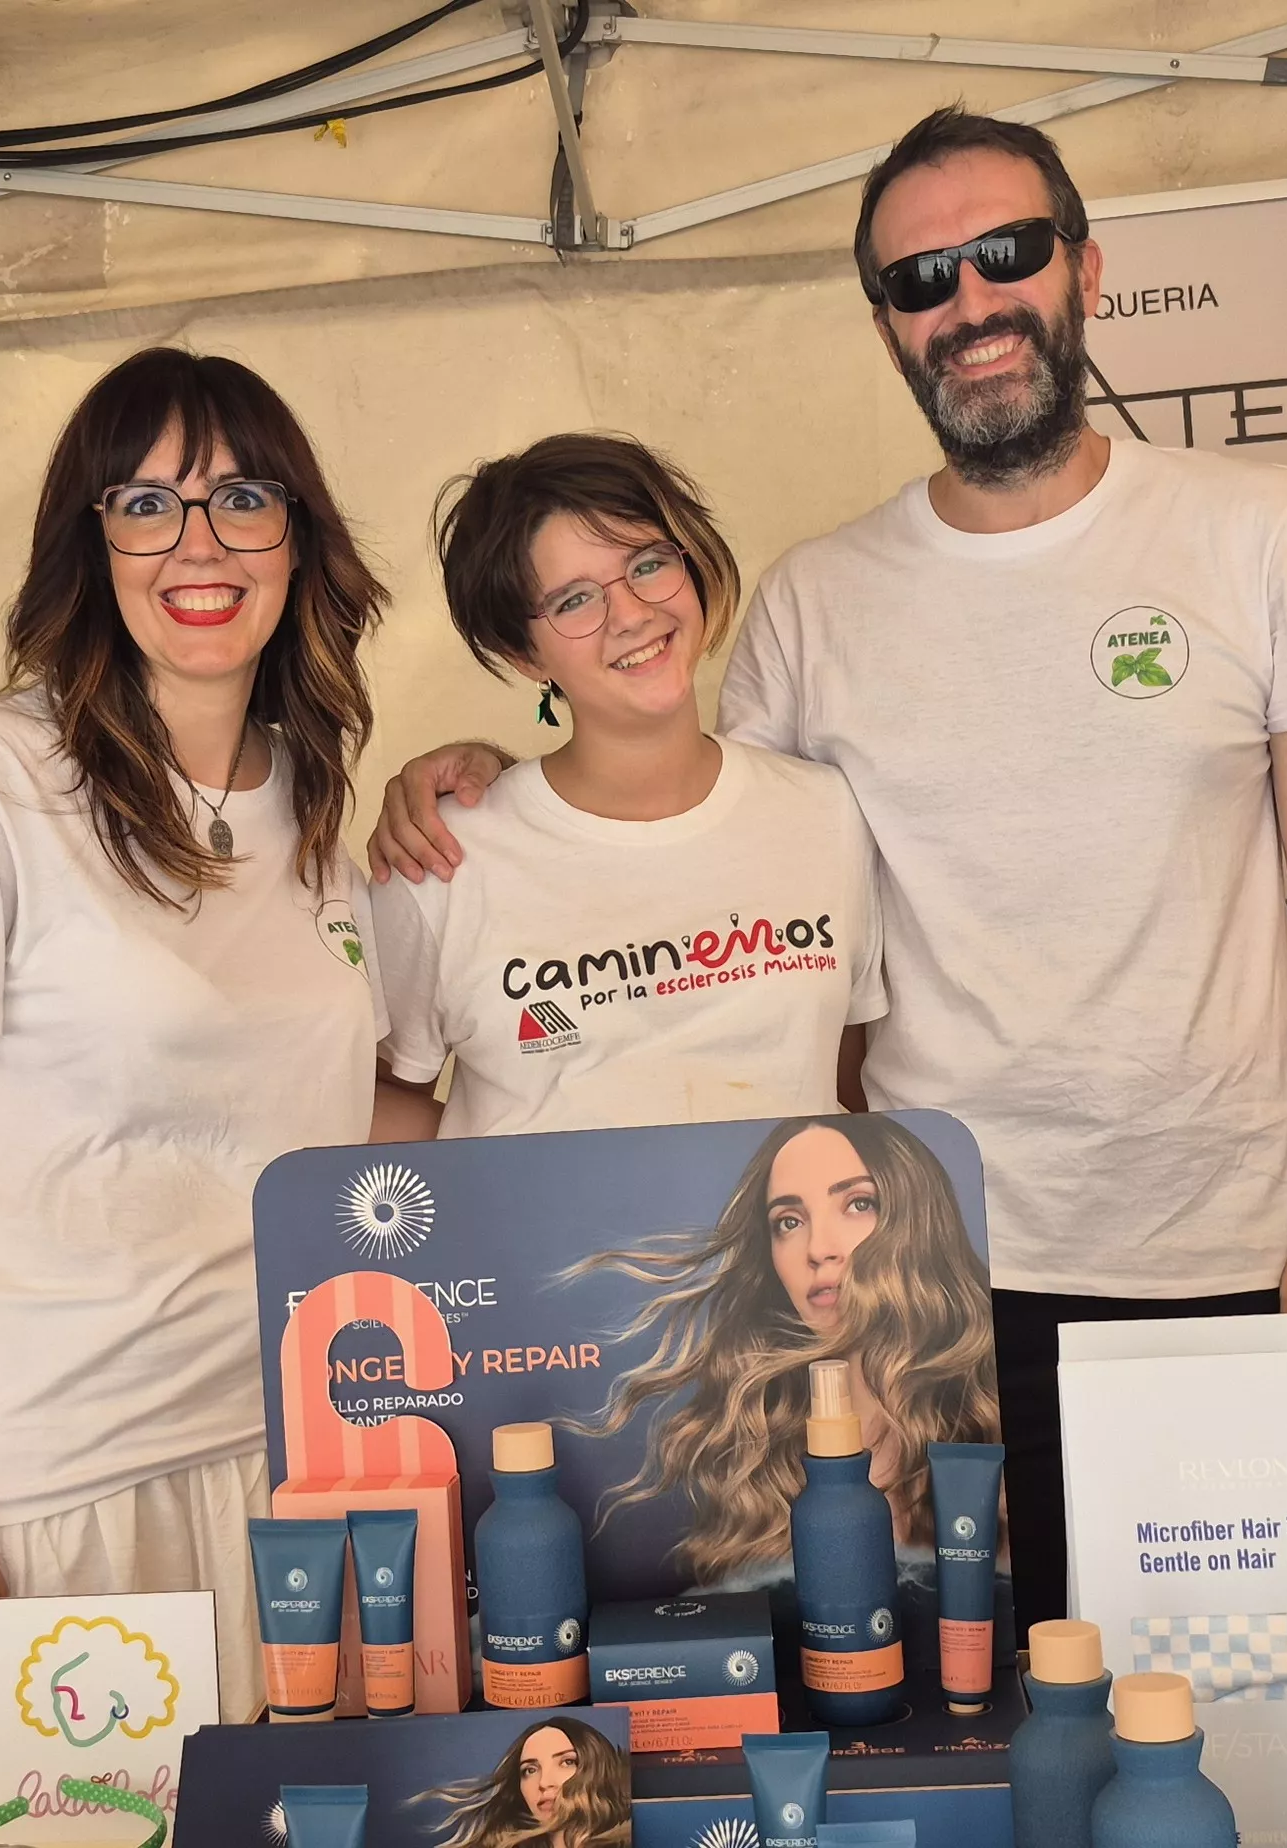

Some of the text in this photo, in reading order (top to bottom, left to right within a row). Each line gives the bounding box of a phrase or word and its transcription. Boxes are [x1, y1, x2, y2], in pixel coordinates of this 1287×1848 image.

[1094, 284, 1219, 320] QUERIA
[1107, 630, 1171, 648] ATENEA
[580, 953, 837, 1011] por la esclerosis múltiple
[482, 1343, 602, 1375] REPAIR
[373, 1393, 464, 1411] REPARADO
[1137, 1519, 1235, 1543] Microfiber
[1241, 1517, 1281, 1539] Hair
[1140, 1547, 1277, 1573] Gentle on Hair
[487, 1633, 544, 1647] EKSPERIENCE
[605, 1665, 687, 1682] EKSPERIENCE
[831, 1747, 905, 1756] ROTEGE
